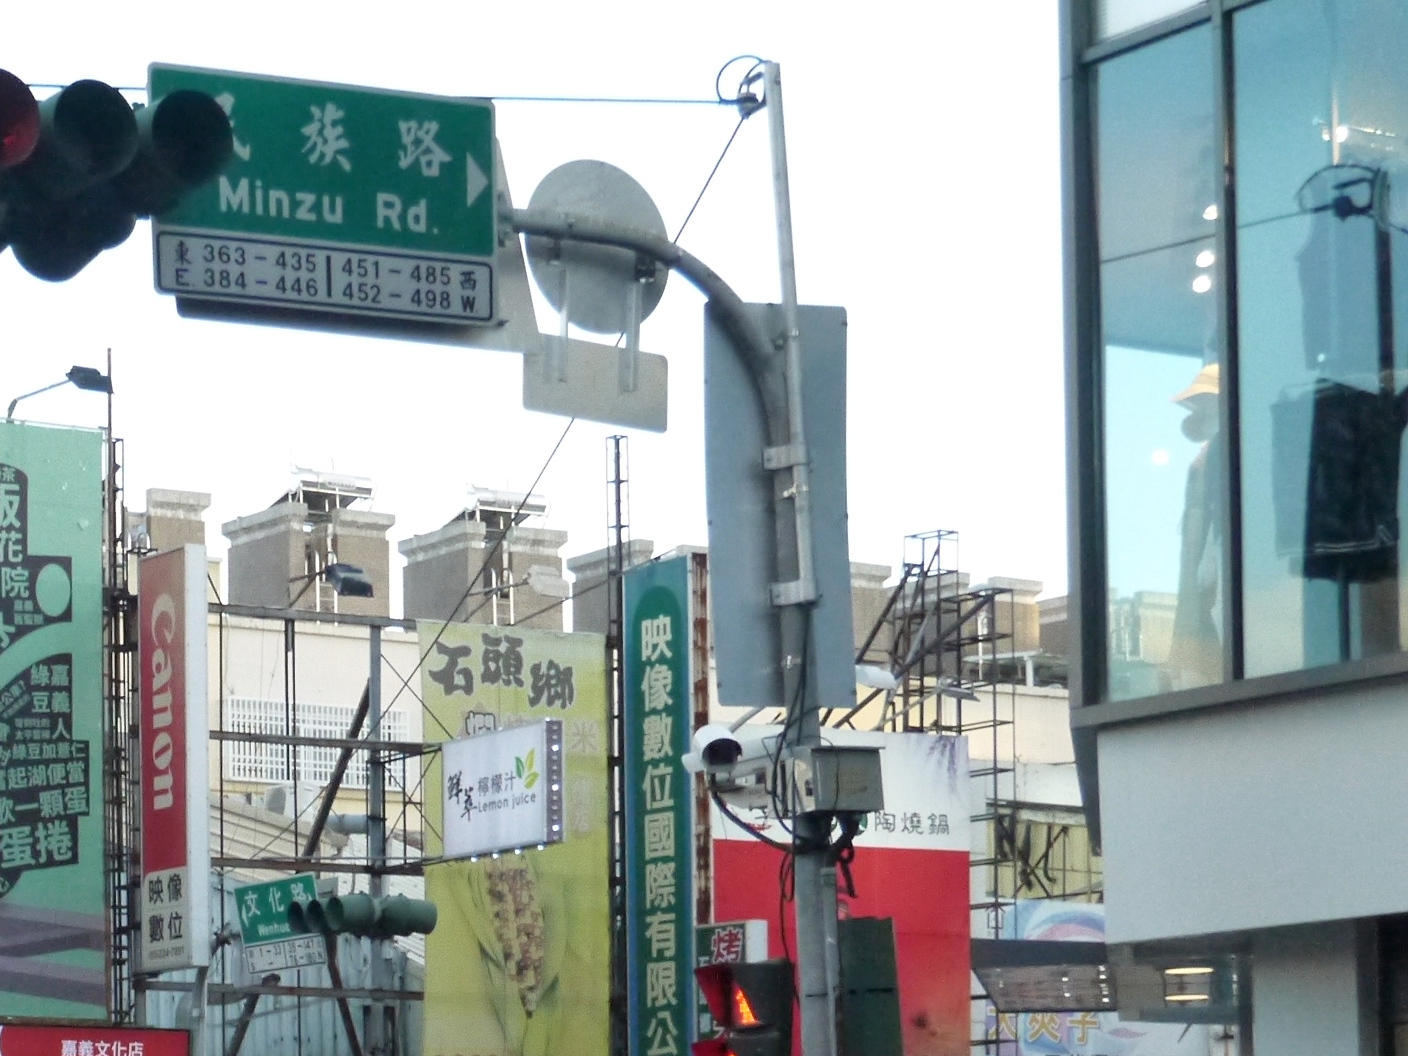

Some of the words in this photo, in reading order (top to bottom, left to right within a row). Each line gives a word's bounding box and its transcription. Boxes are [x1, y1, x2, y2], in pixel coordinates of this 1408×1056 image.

[218, 176, 343, 224] Minzu
[376, 192, 438, 234] Rd.
[175, 240, 192, 265] 東
[459, 270, 478, 291] 西
[175, 268, 189, 287] E
[461, 294, 477, 314] W
[428, 632, 574, 709] 石頭鄉
[151, 592, 175, 811] Canon
[512, 793, 537, 810] juice
[149, 873, 182, 904] 映像
[149, 911, 183, 943] 數位
